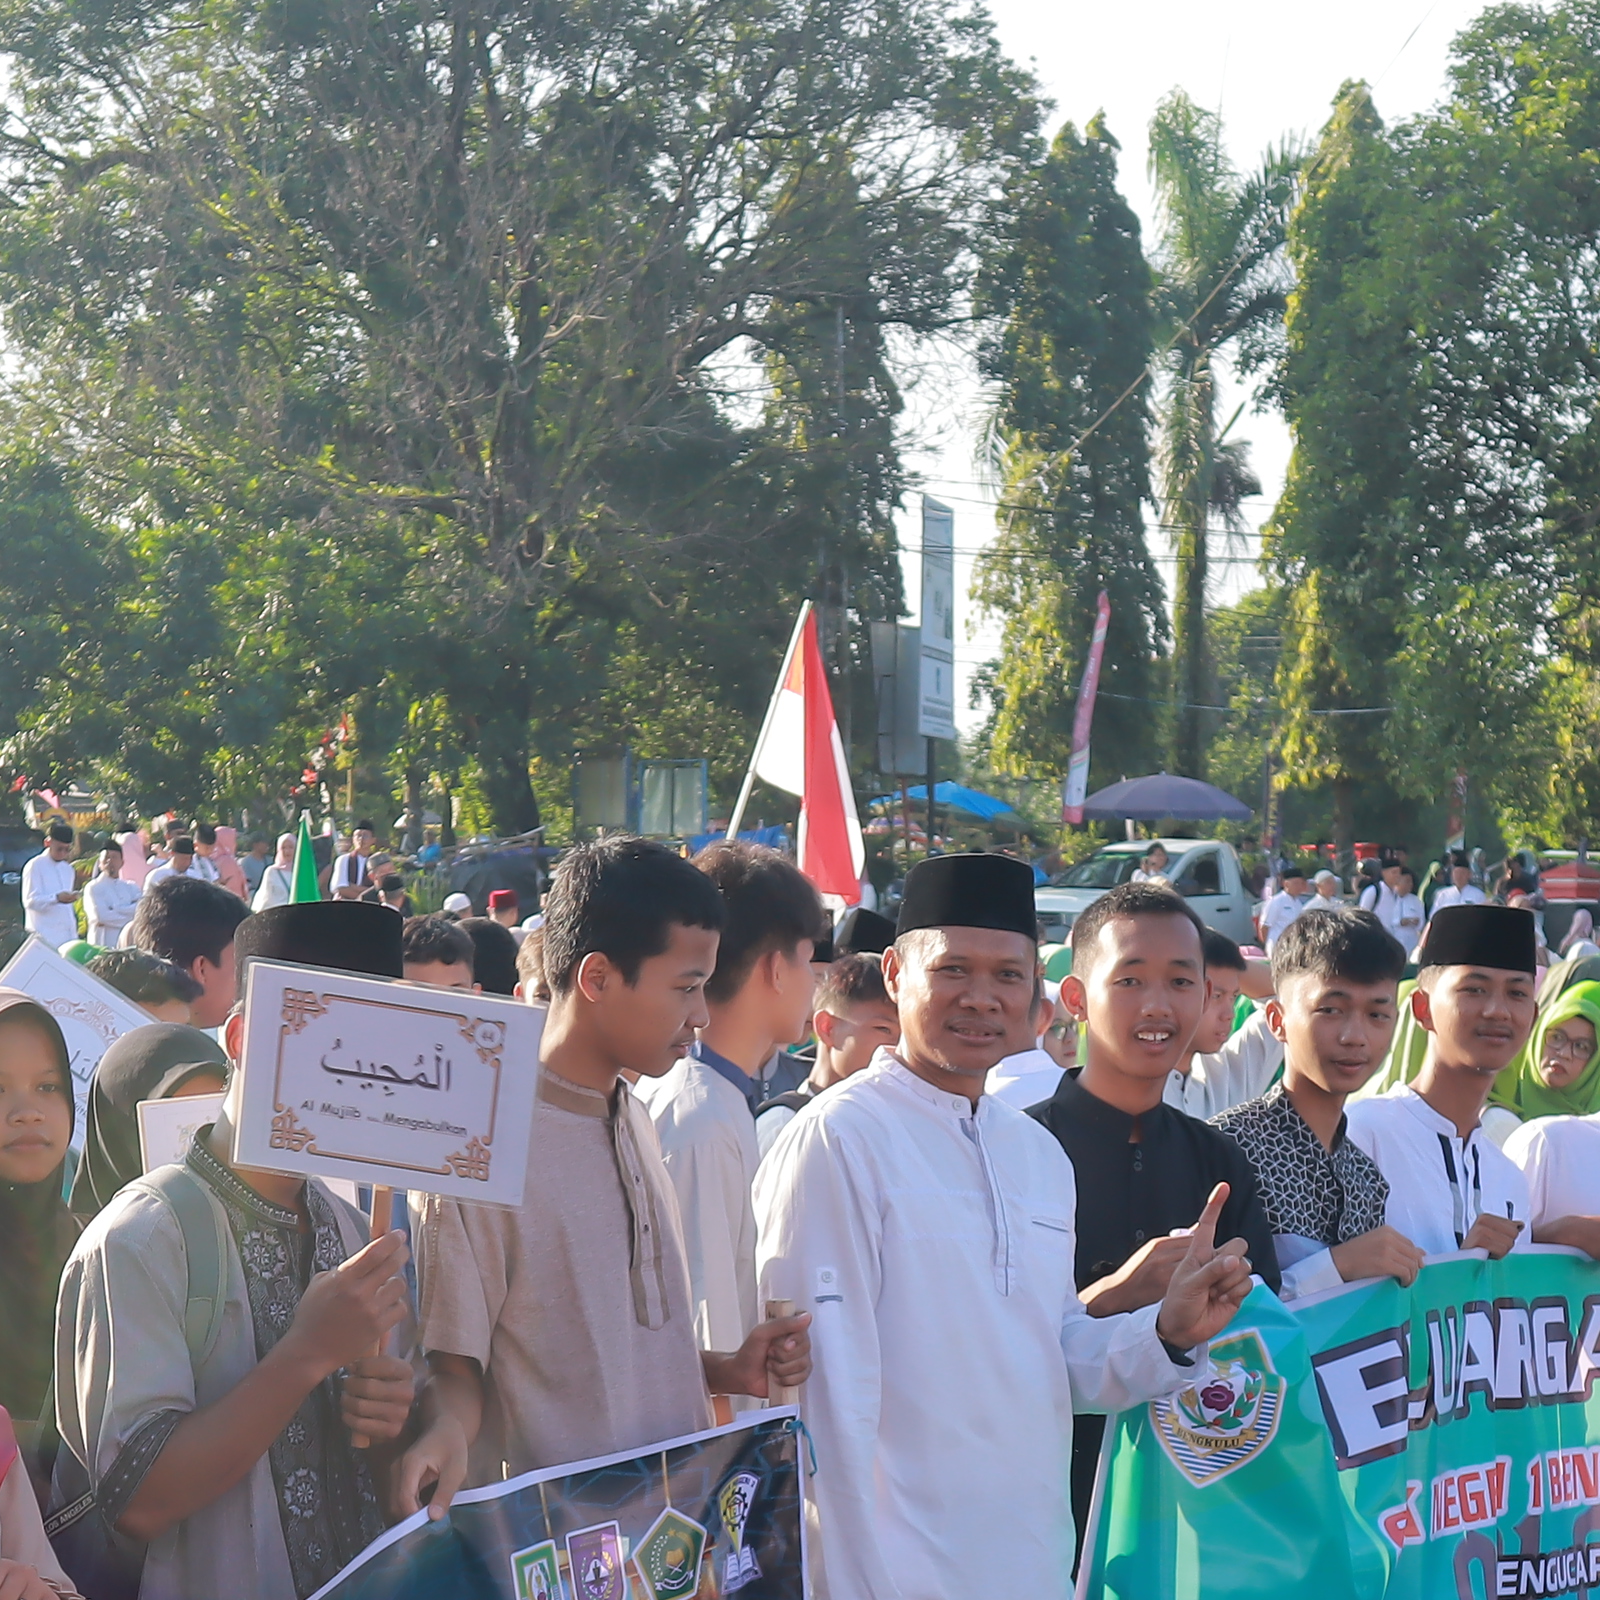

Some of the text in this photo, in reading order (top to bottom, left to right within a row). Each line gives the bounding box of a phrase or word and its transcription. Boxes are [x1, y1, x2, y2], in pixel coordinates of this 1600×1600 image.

[301, 1100, 314, 1112] Al
[384, 1112, 468, 1137] Mengabulkan
[1176, 1425, 1241, 1449] BENGKULU
[1530, 1455, 1542, 1510] 1
